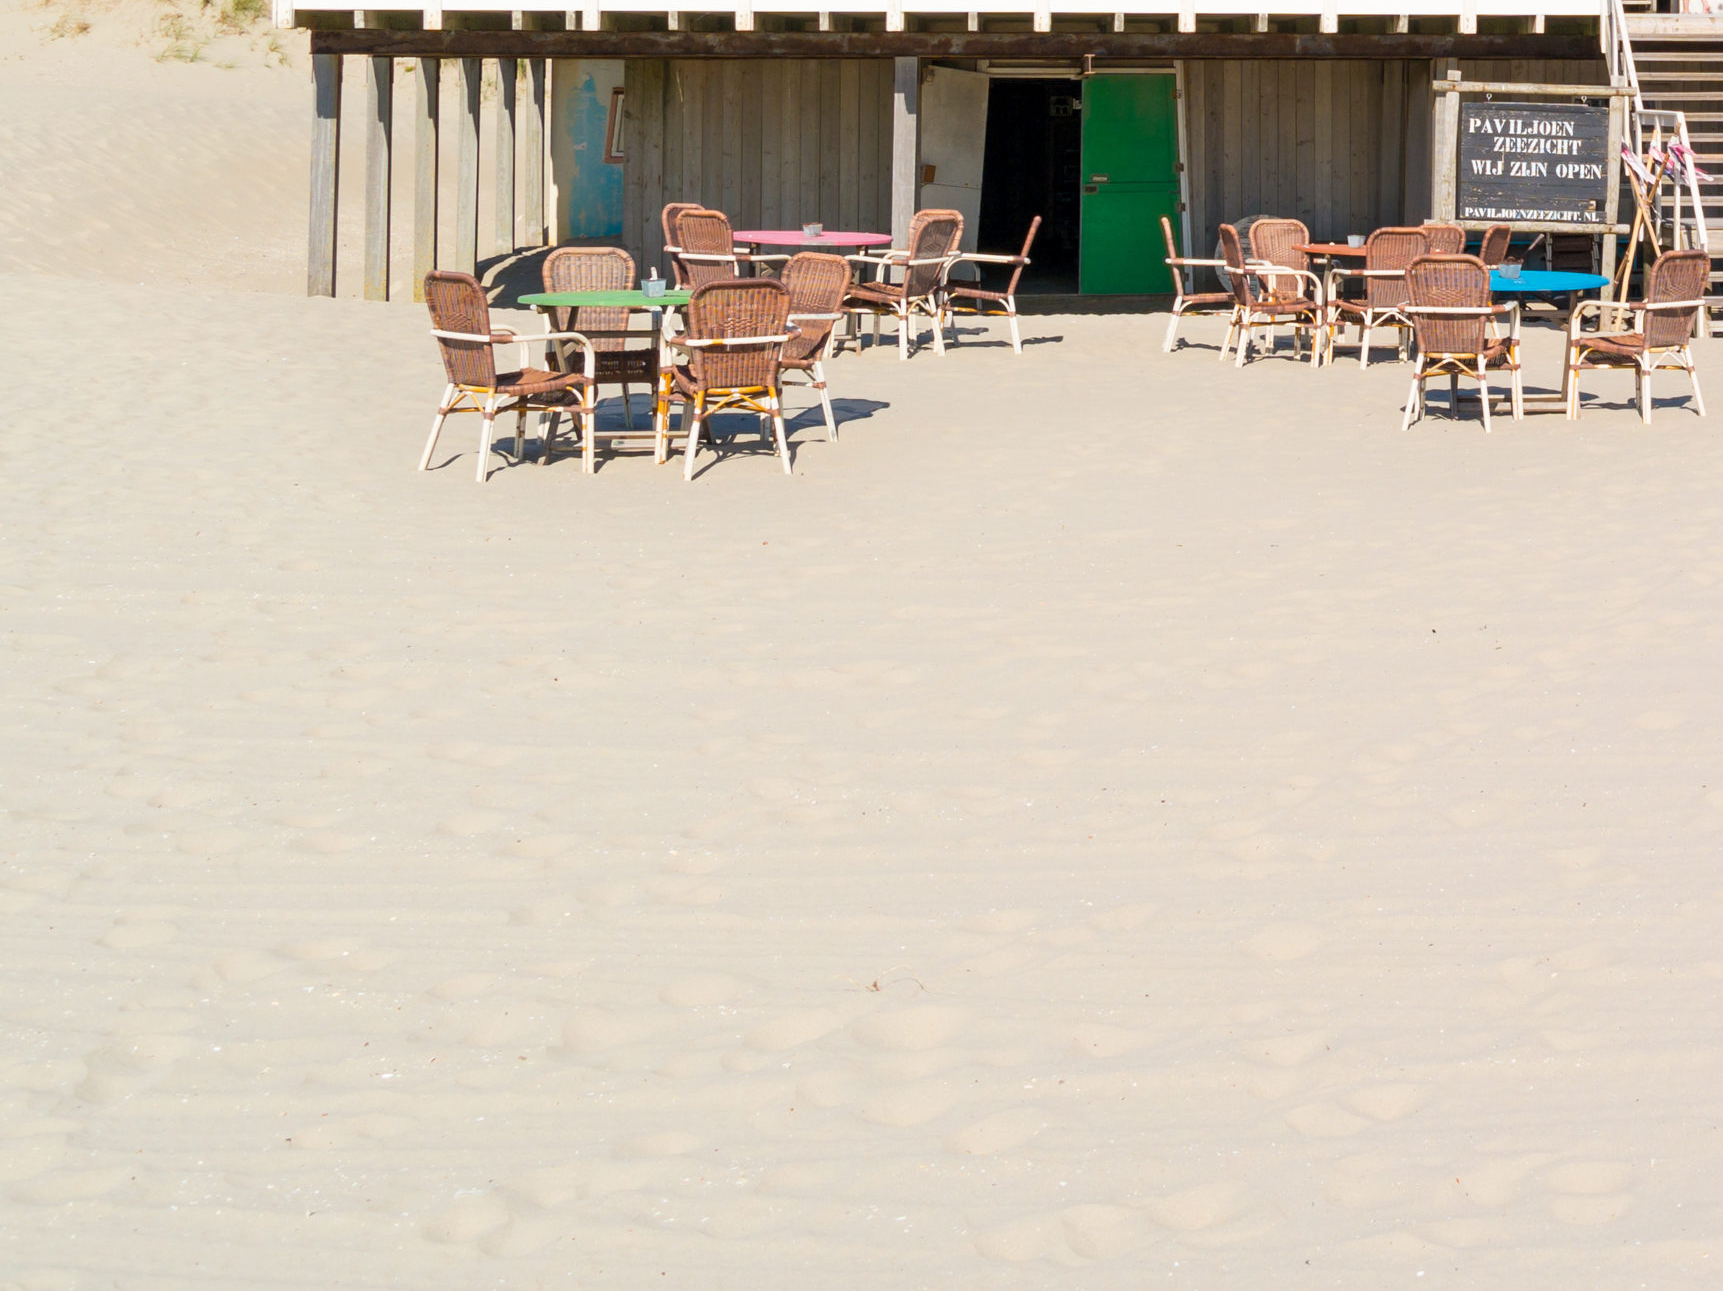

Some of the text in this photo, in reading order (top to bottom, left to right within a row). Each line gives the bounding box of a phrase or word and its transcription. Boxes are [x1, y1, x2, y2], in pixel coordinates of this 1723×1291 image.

[1468, 117, 1575, 137] PAVILJOEN
[1493, 136, 1582, 156] ZEEZICHT
[1471, 159, 1602, 180] WIJ ZIJN OPEN
